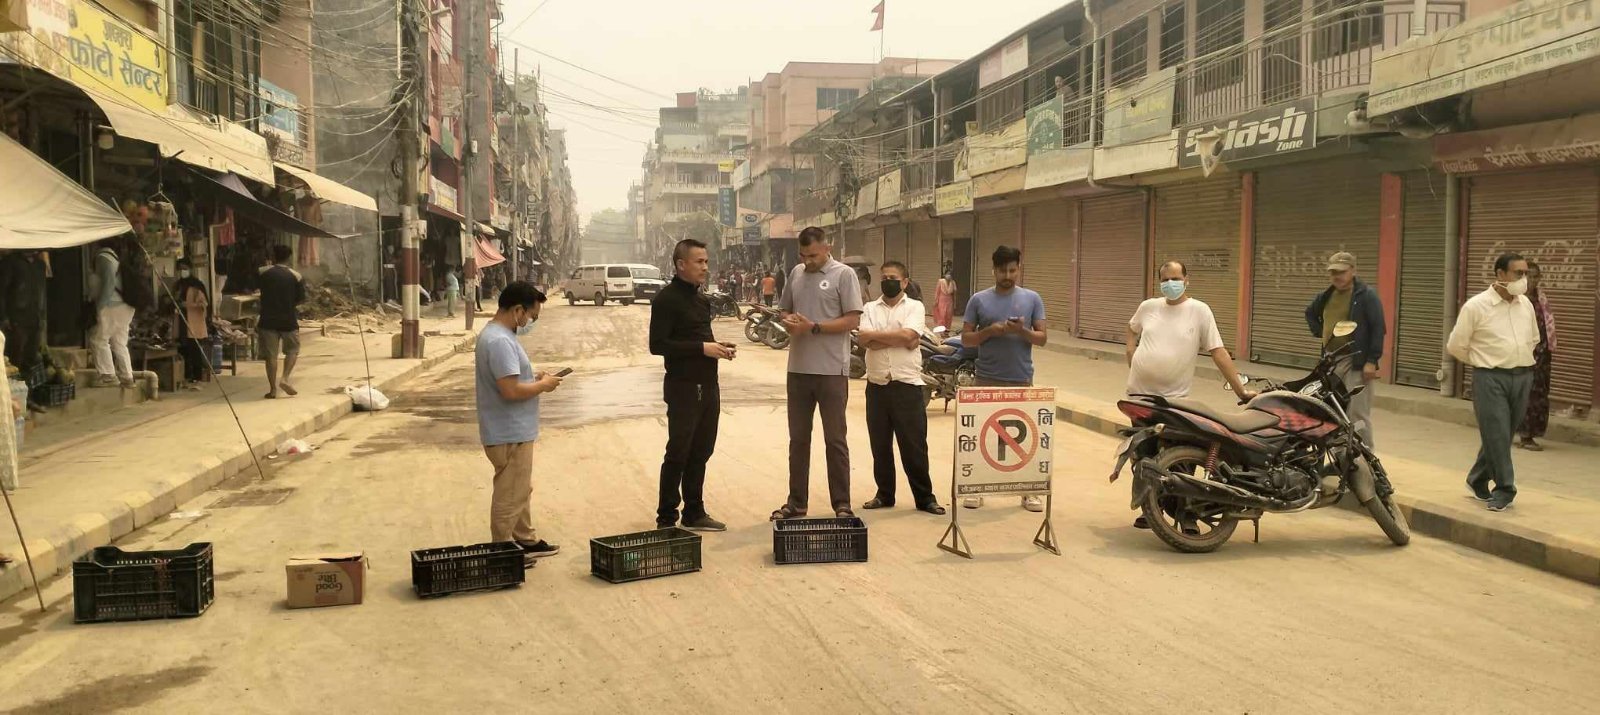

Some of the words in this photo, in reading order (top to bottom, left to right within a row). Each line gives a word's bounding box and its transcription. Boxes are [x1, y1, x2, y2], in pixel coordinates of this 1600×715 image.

[68, 33, 113, 80] फोटो
[118, 51, 163, 97] सेन्टर
[1185, 107, 1307, 157] Slash
[1276, 140, 1303, 152] Zone
[315, 582, 343, 593] Good
